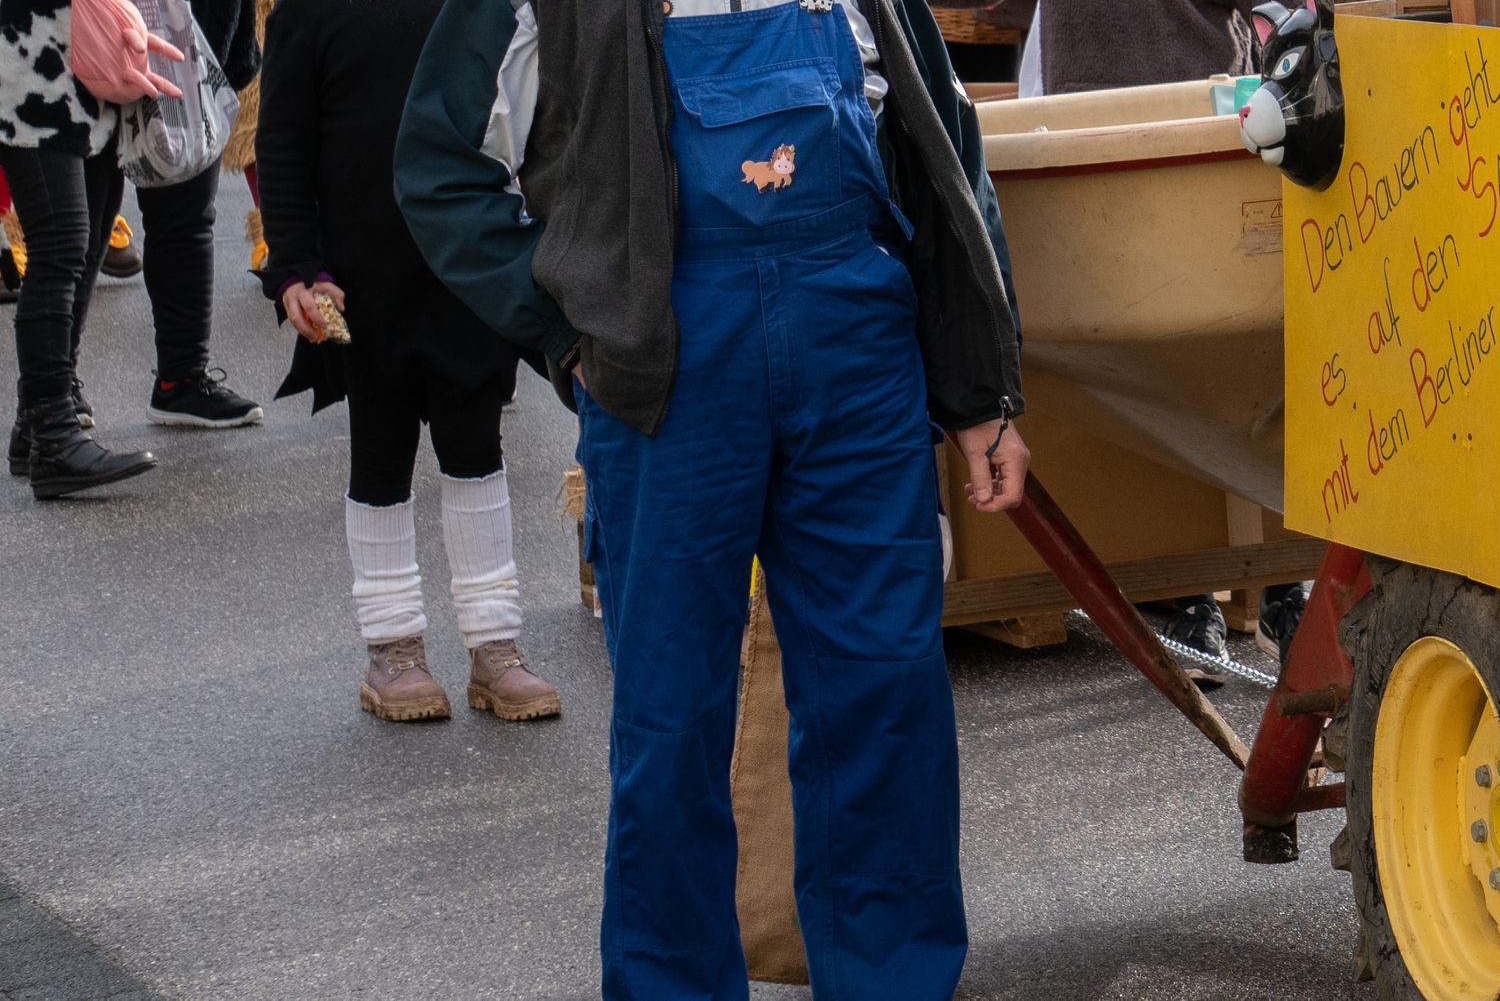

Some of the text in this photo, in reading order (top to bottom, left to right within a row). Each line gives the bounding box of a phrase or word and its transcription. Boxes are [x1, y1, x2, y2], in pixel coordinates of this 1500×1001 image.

[1301, 218, 1354, 293] Den
[1349, 123, 1439, 245] Bauern
[1448, 38, 1500, 191] geht
[1321, 353, 1346, 406] es
[1367, 258, 1402, 354] auf
[1411, 234, 1459, 313] den
[1321, 439, 1359, 523] mit
[1366, 400, 1410, 478] dem
[1410, 306, 1497, 428] Berliner
